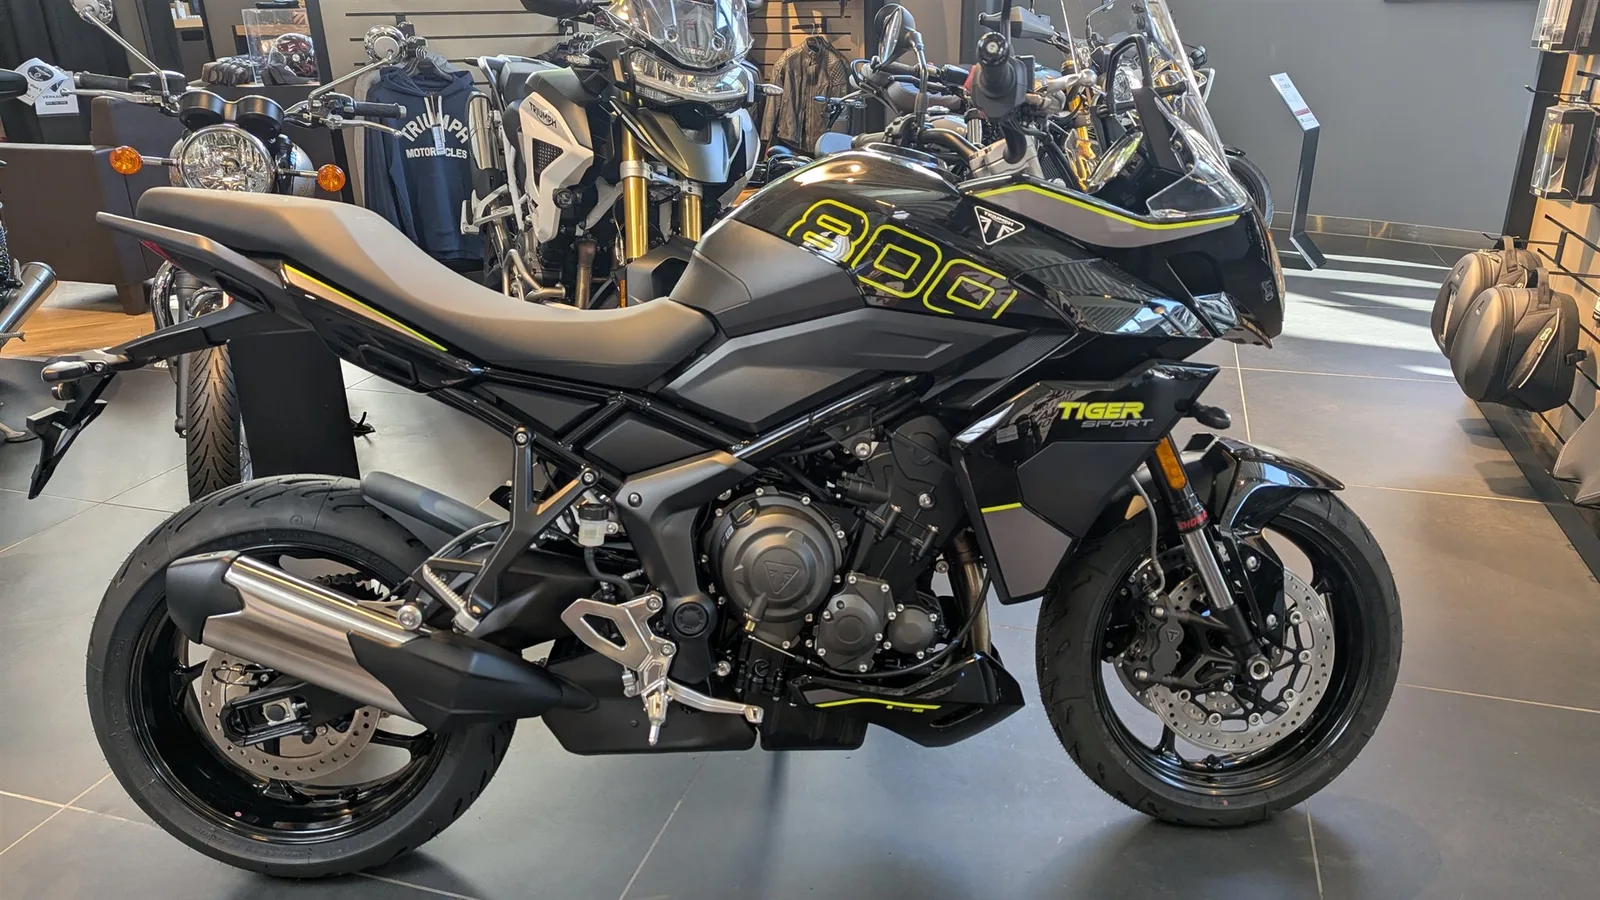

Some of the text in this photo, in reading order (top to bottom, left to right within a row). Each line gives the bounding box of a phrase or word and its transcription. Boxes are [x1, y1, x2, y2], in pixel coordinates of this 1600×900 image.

[401, 113, 468, 144] TRIUMPH
[405, 146, 467, 159] MOTORCLES
[1058, 402, 1144, 419] TIGER
[1081, 419, 1154, 428] SPORT
